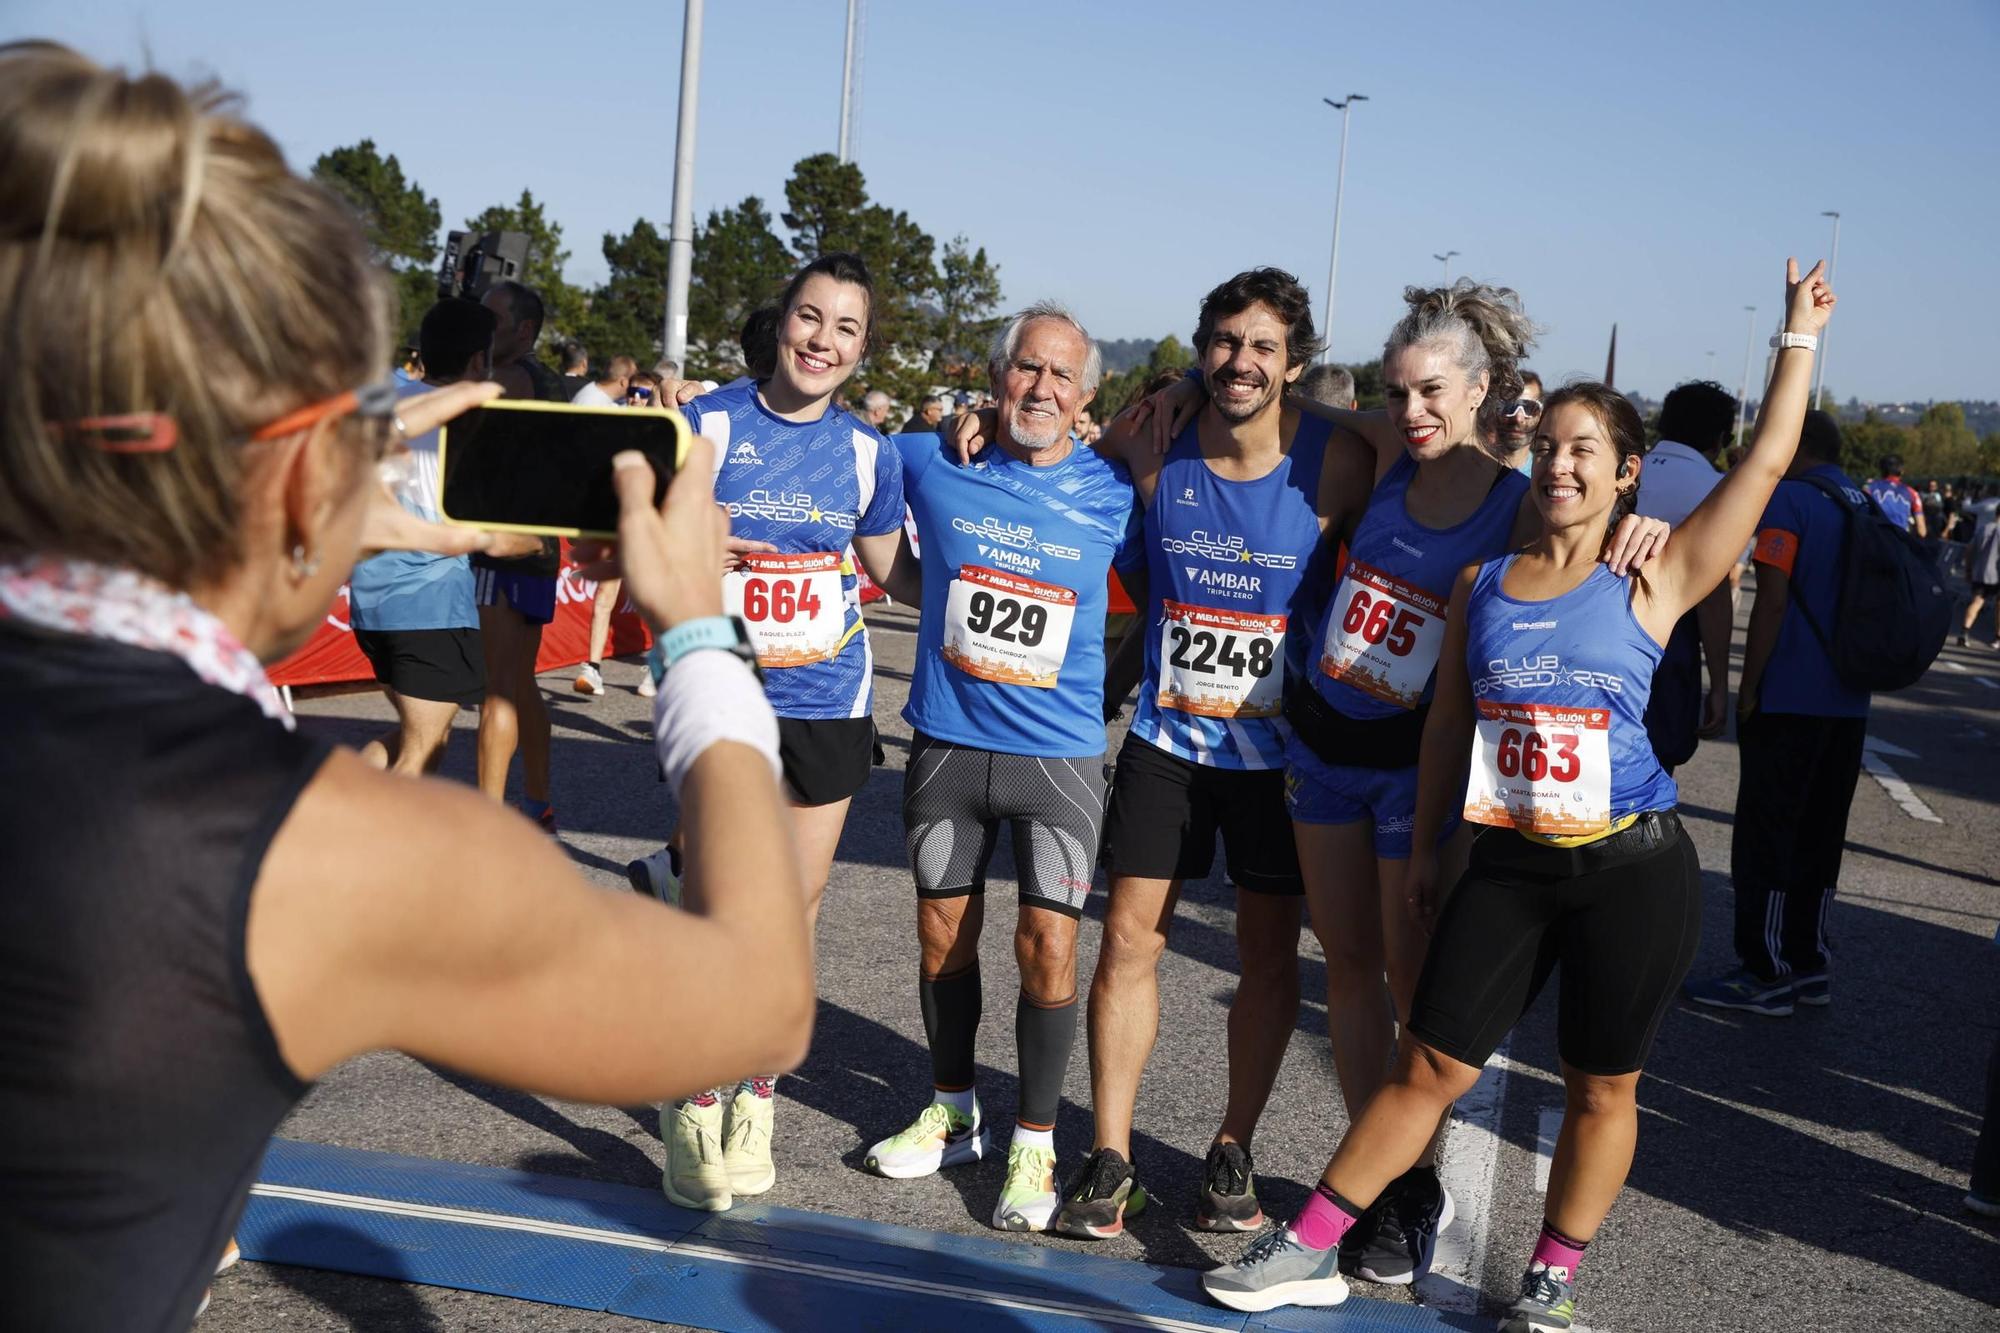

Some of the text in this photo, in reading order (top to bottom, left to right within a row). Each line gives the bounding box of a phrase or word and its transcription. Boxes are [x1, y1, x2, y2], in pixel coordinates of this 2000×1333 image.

[750, 490, 811, 507] CLUB
[983, 517, 1032, 537] CLUB
[1192, 530, 1244, 549] CLUB
[760, 561, 785, 569] MBA
[803, 558, 824, 568] GIJÓN
[988, 548, 1041, 570] AMBAR
[995, 562, 1033, 575] TRIPLE ZERO
[989, 575, 1014, 589] MBA
[1033, 586, 1060, 599] GIJÓN
[1198, 569, 1262, 592] AMBAR
[744, 578, 821, 623] 664
[1206, 587, 1253, 600] TRIPLE ZERO
[1371, 575, 1393, 591] MBA
[1411, 593, 1440, 611] GIJÓN
[967, 591, 1048, 647] 929
[1196, 613, 1220, 623] MBA
[1239, 619, 1266, 628] GIJÓN
[1343, 590, 1426, 657] 665
[972, 641, 998, 653] MANUEL
[1169, 626, 1274, 679] 2248
[1488, 655, 1558, 672] CLUB
[1196, 680, 1240, 691] JORGE BENITO
[1511, 710, 1533, 720] MBA
[1556, 712, 1586, 723] GIJÓN
[1497, 728, 1581, 782] 663
[1511, 788, 1531, 797] MARTA
